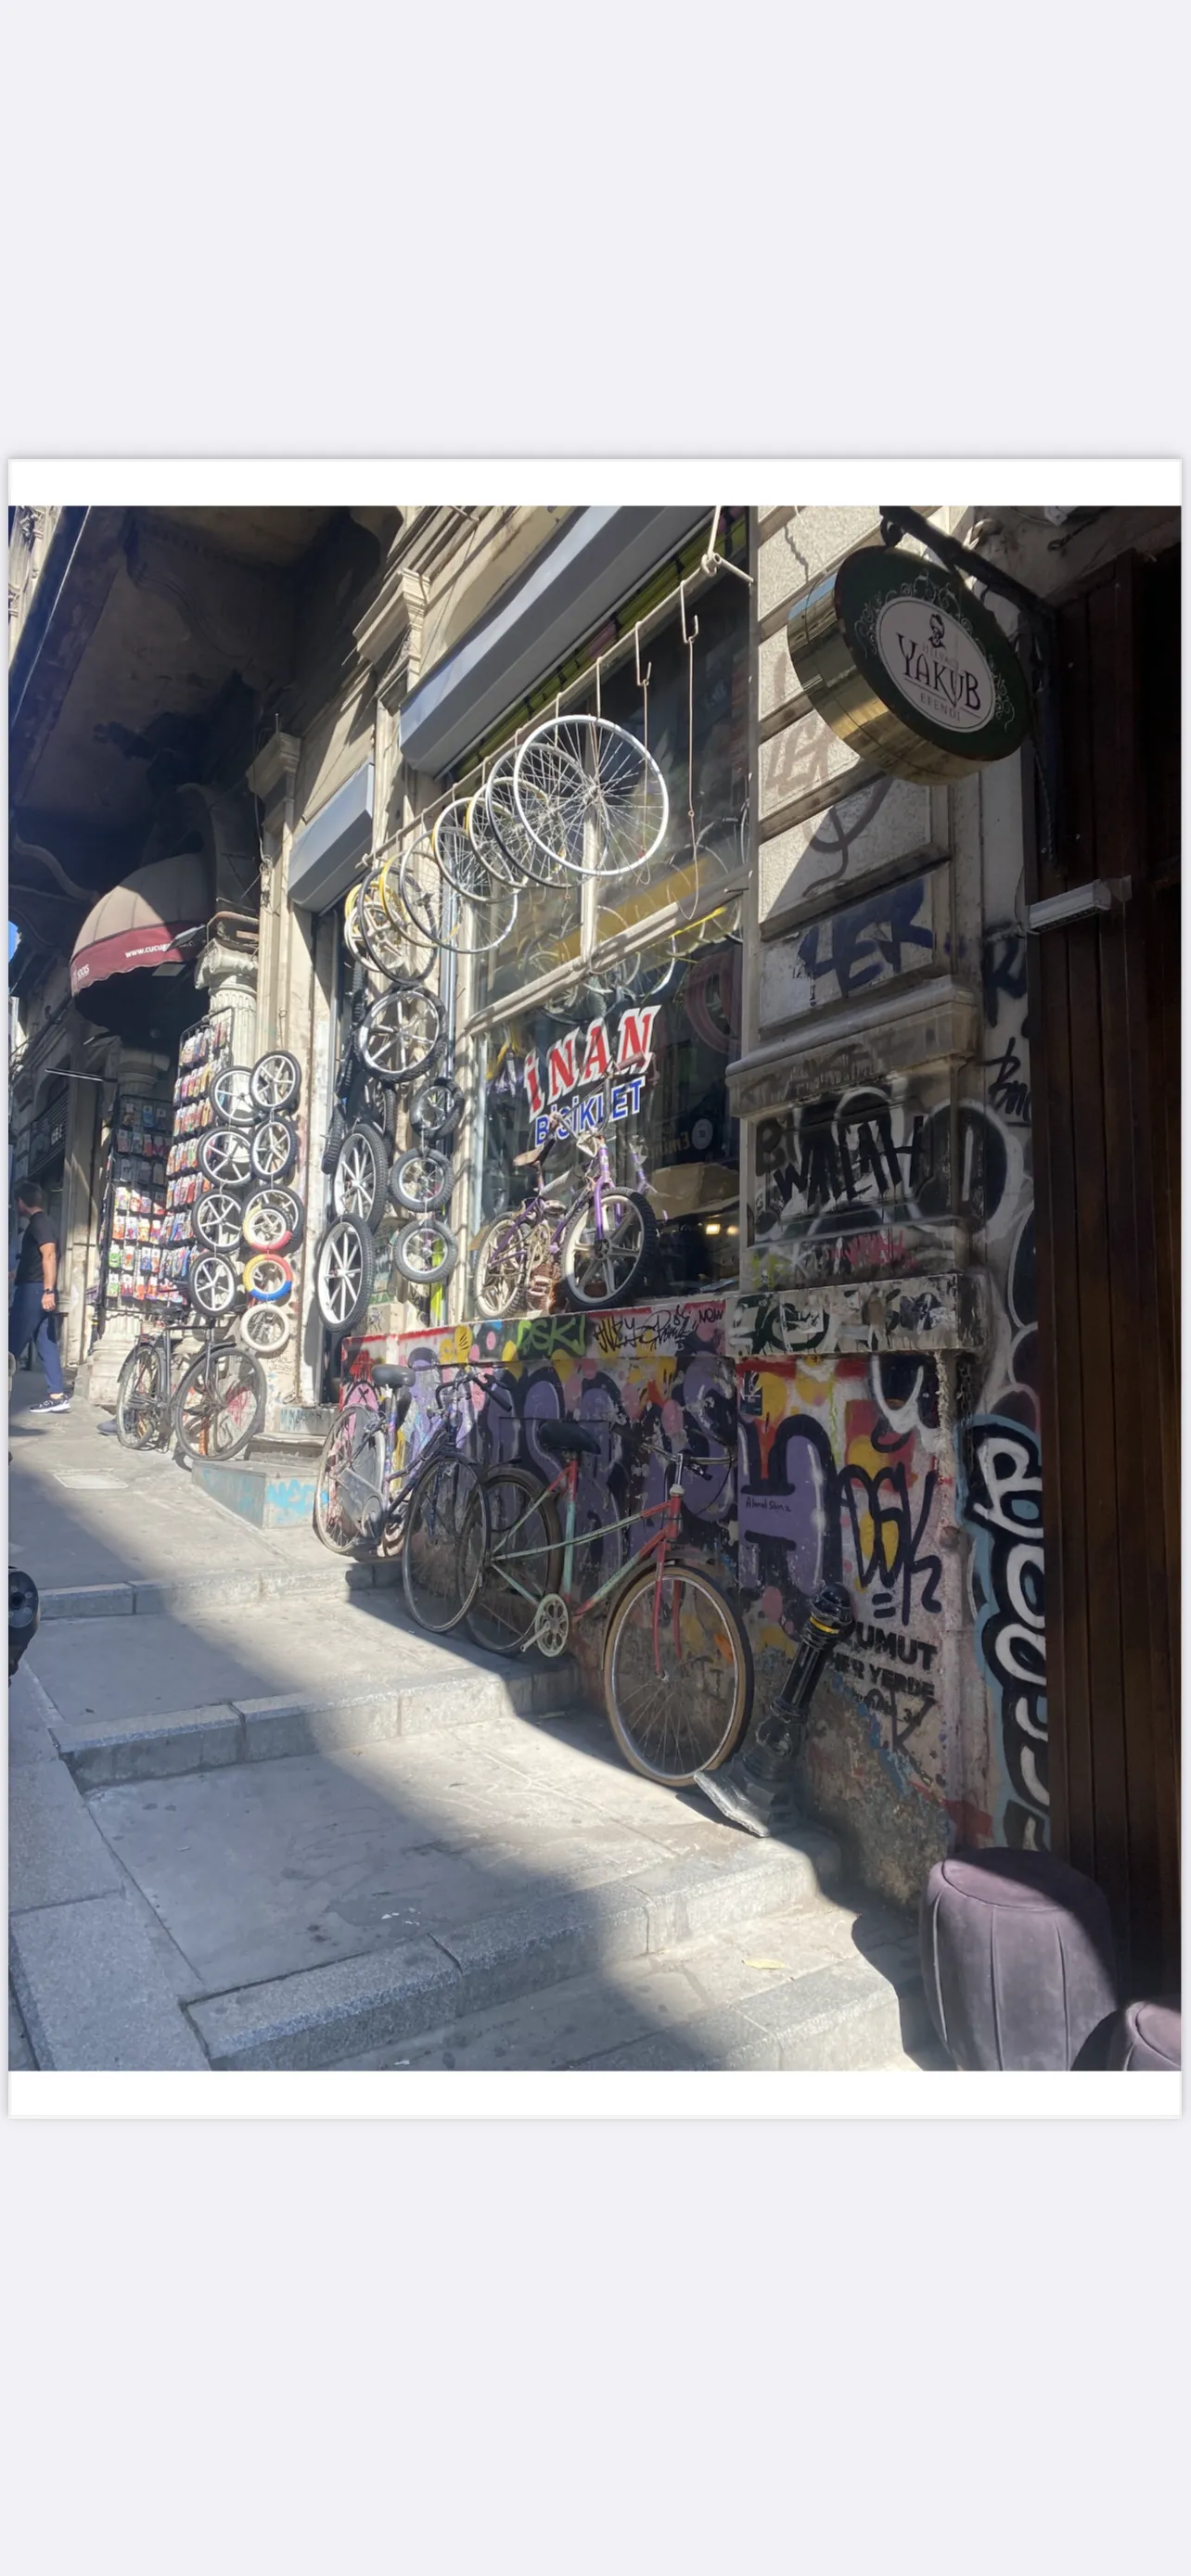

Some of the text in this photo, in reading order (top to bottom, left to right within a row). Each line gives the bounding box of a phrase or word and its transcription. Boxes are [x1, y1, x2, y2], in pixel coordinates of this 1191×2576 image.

[896, 632, 981, 710] YAKUB
[535, 1076, 646, 1147] BSİKLET
[856, 1621, 937, 1671] UMUT
